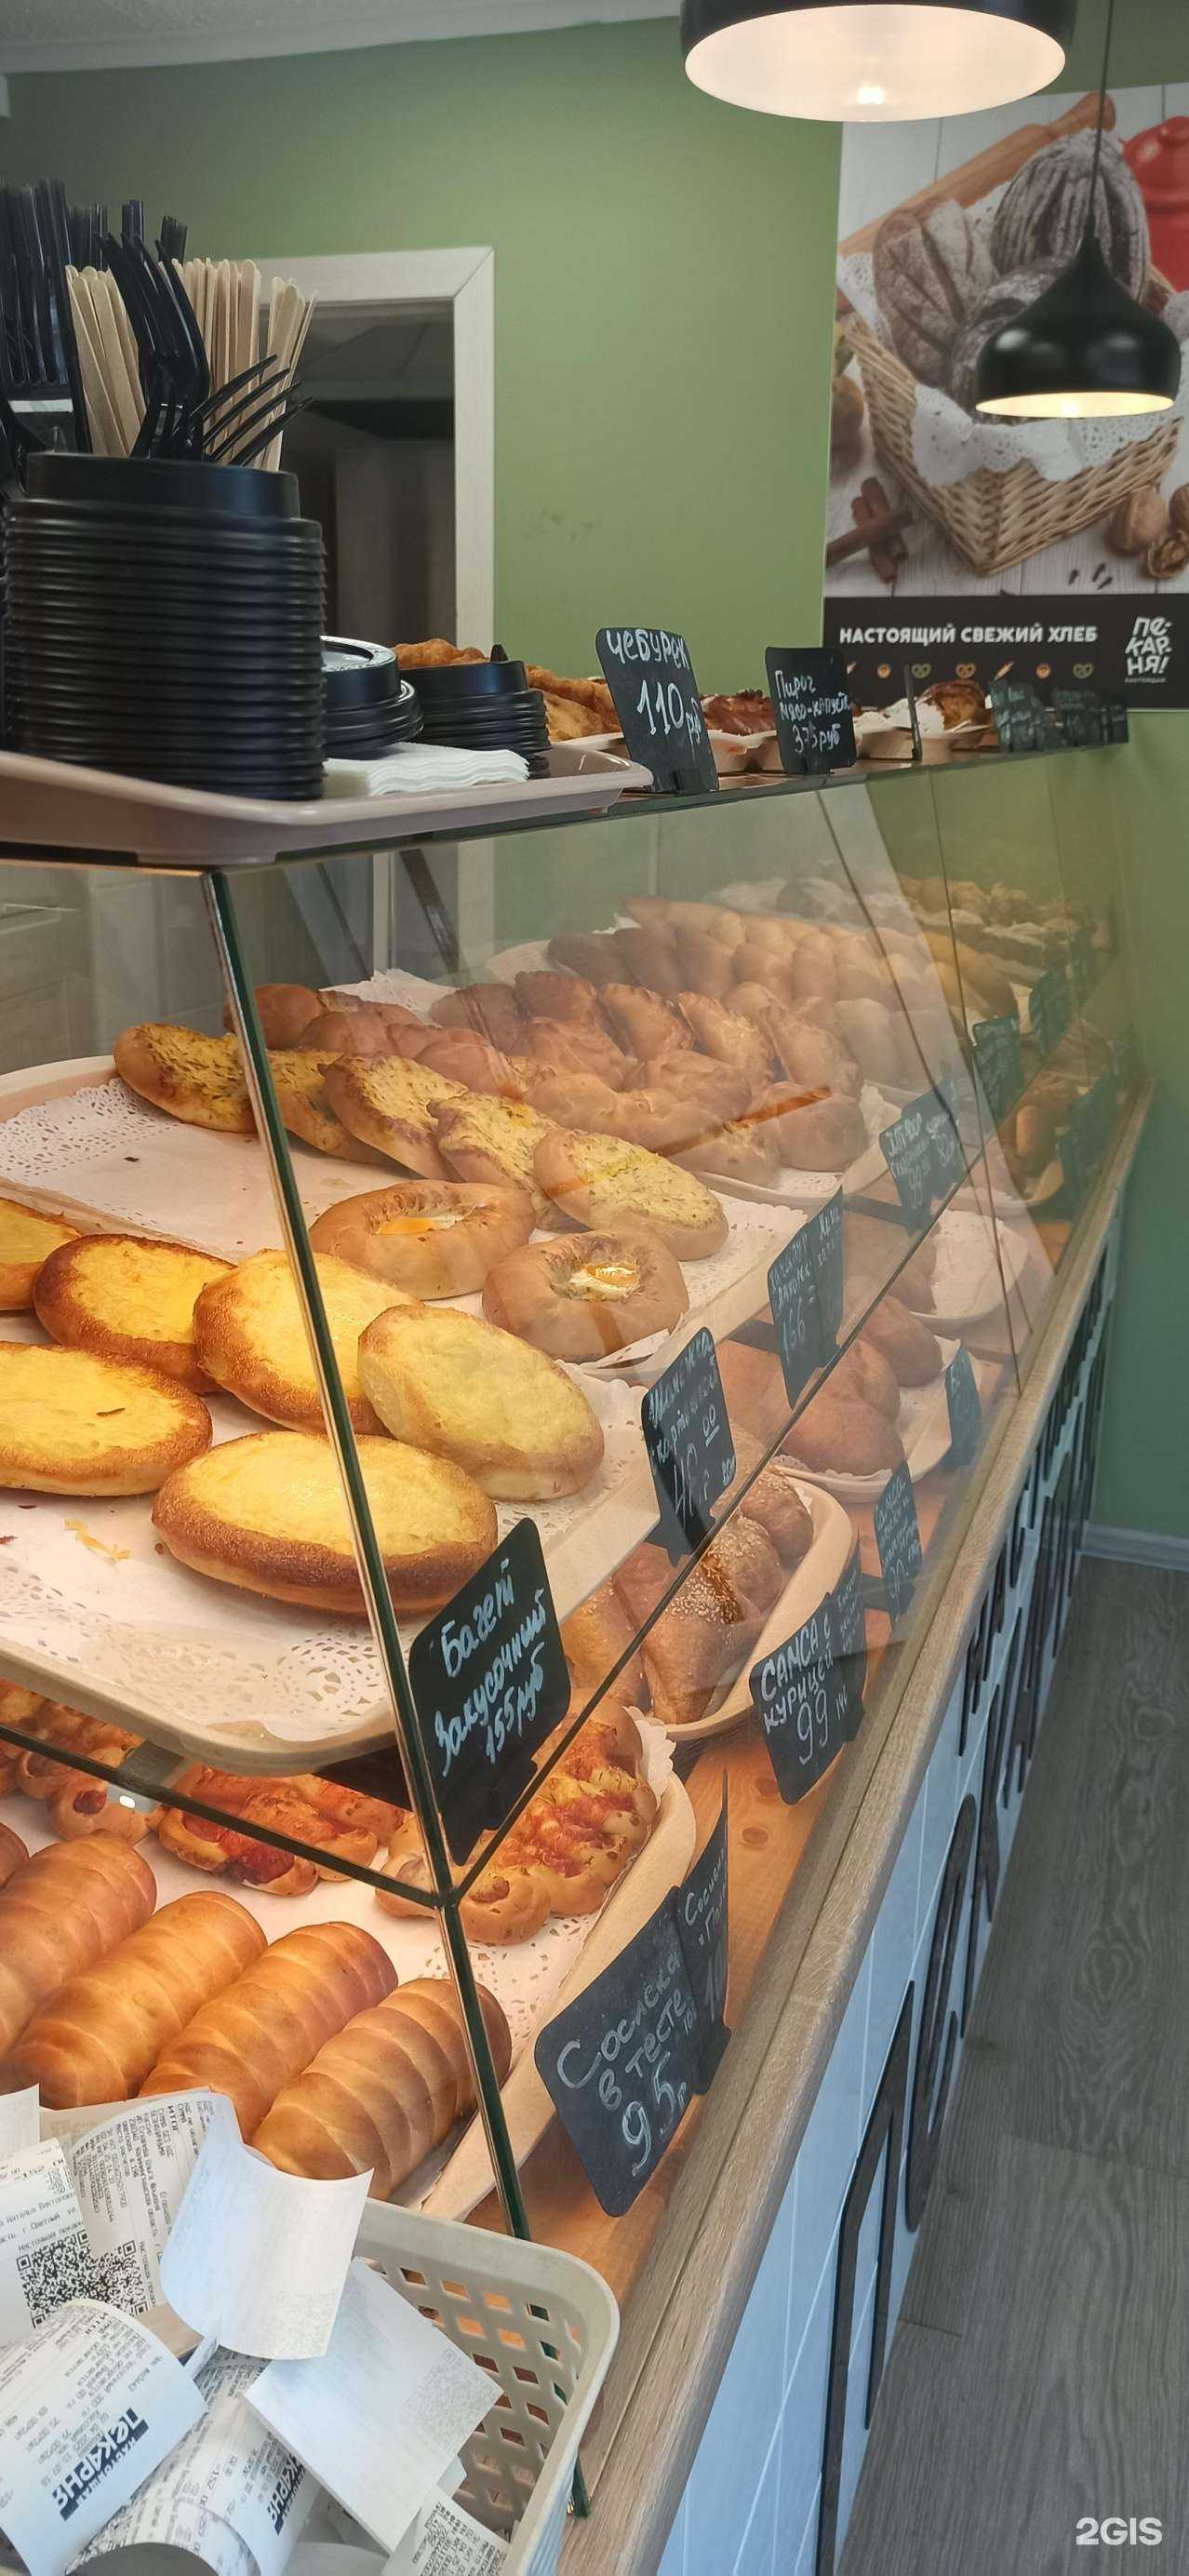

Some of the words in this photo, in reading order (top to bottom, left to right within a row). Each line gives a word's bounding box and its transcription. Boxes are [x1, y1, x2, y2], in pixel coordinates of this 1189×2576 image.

[839, 624, 955, 646] НАСТОЯЩИЙ
[960, 623, 1043, 643] СВЕЖИЙ
[1048, 626, 1097, 643] ХЛЕБ
[1127, 655, 1169, 676] НЯ!
[637, 679, 685, 735] 110
[774, 670, 816, 699] Пирог
[441, 1557, 514, 1678] Багет
[761, 1617, 819, 1701] САМСА
[796, 1689, 828, 1764] 99
[556, 1949, 682, 2089] Сосиска
[167, 2104, 179, 2132] ИТОГ
[621, 2051, 675, 2177] 95
